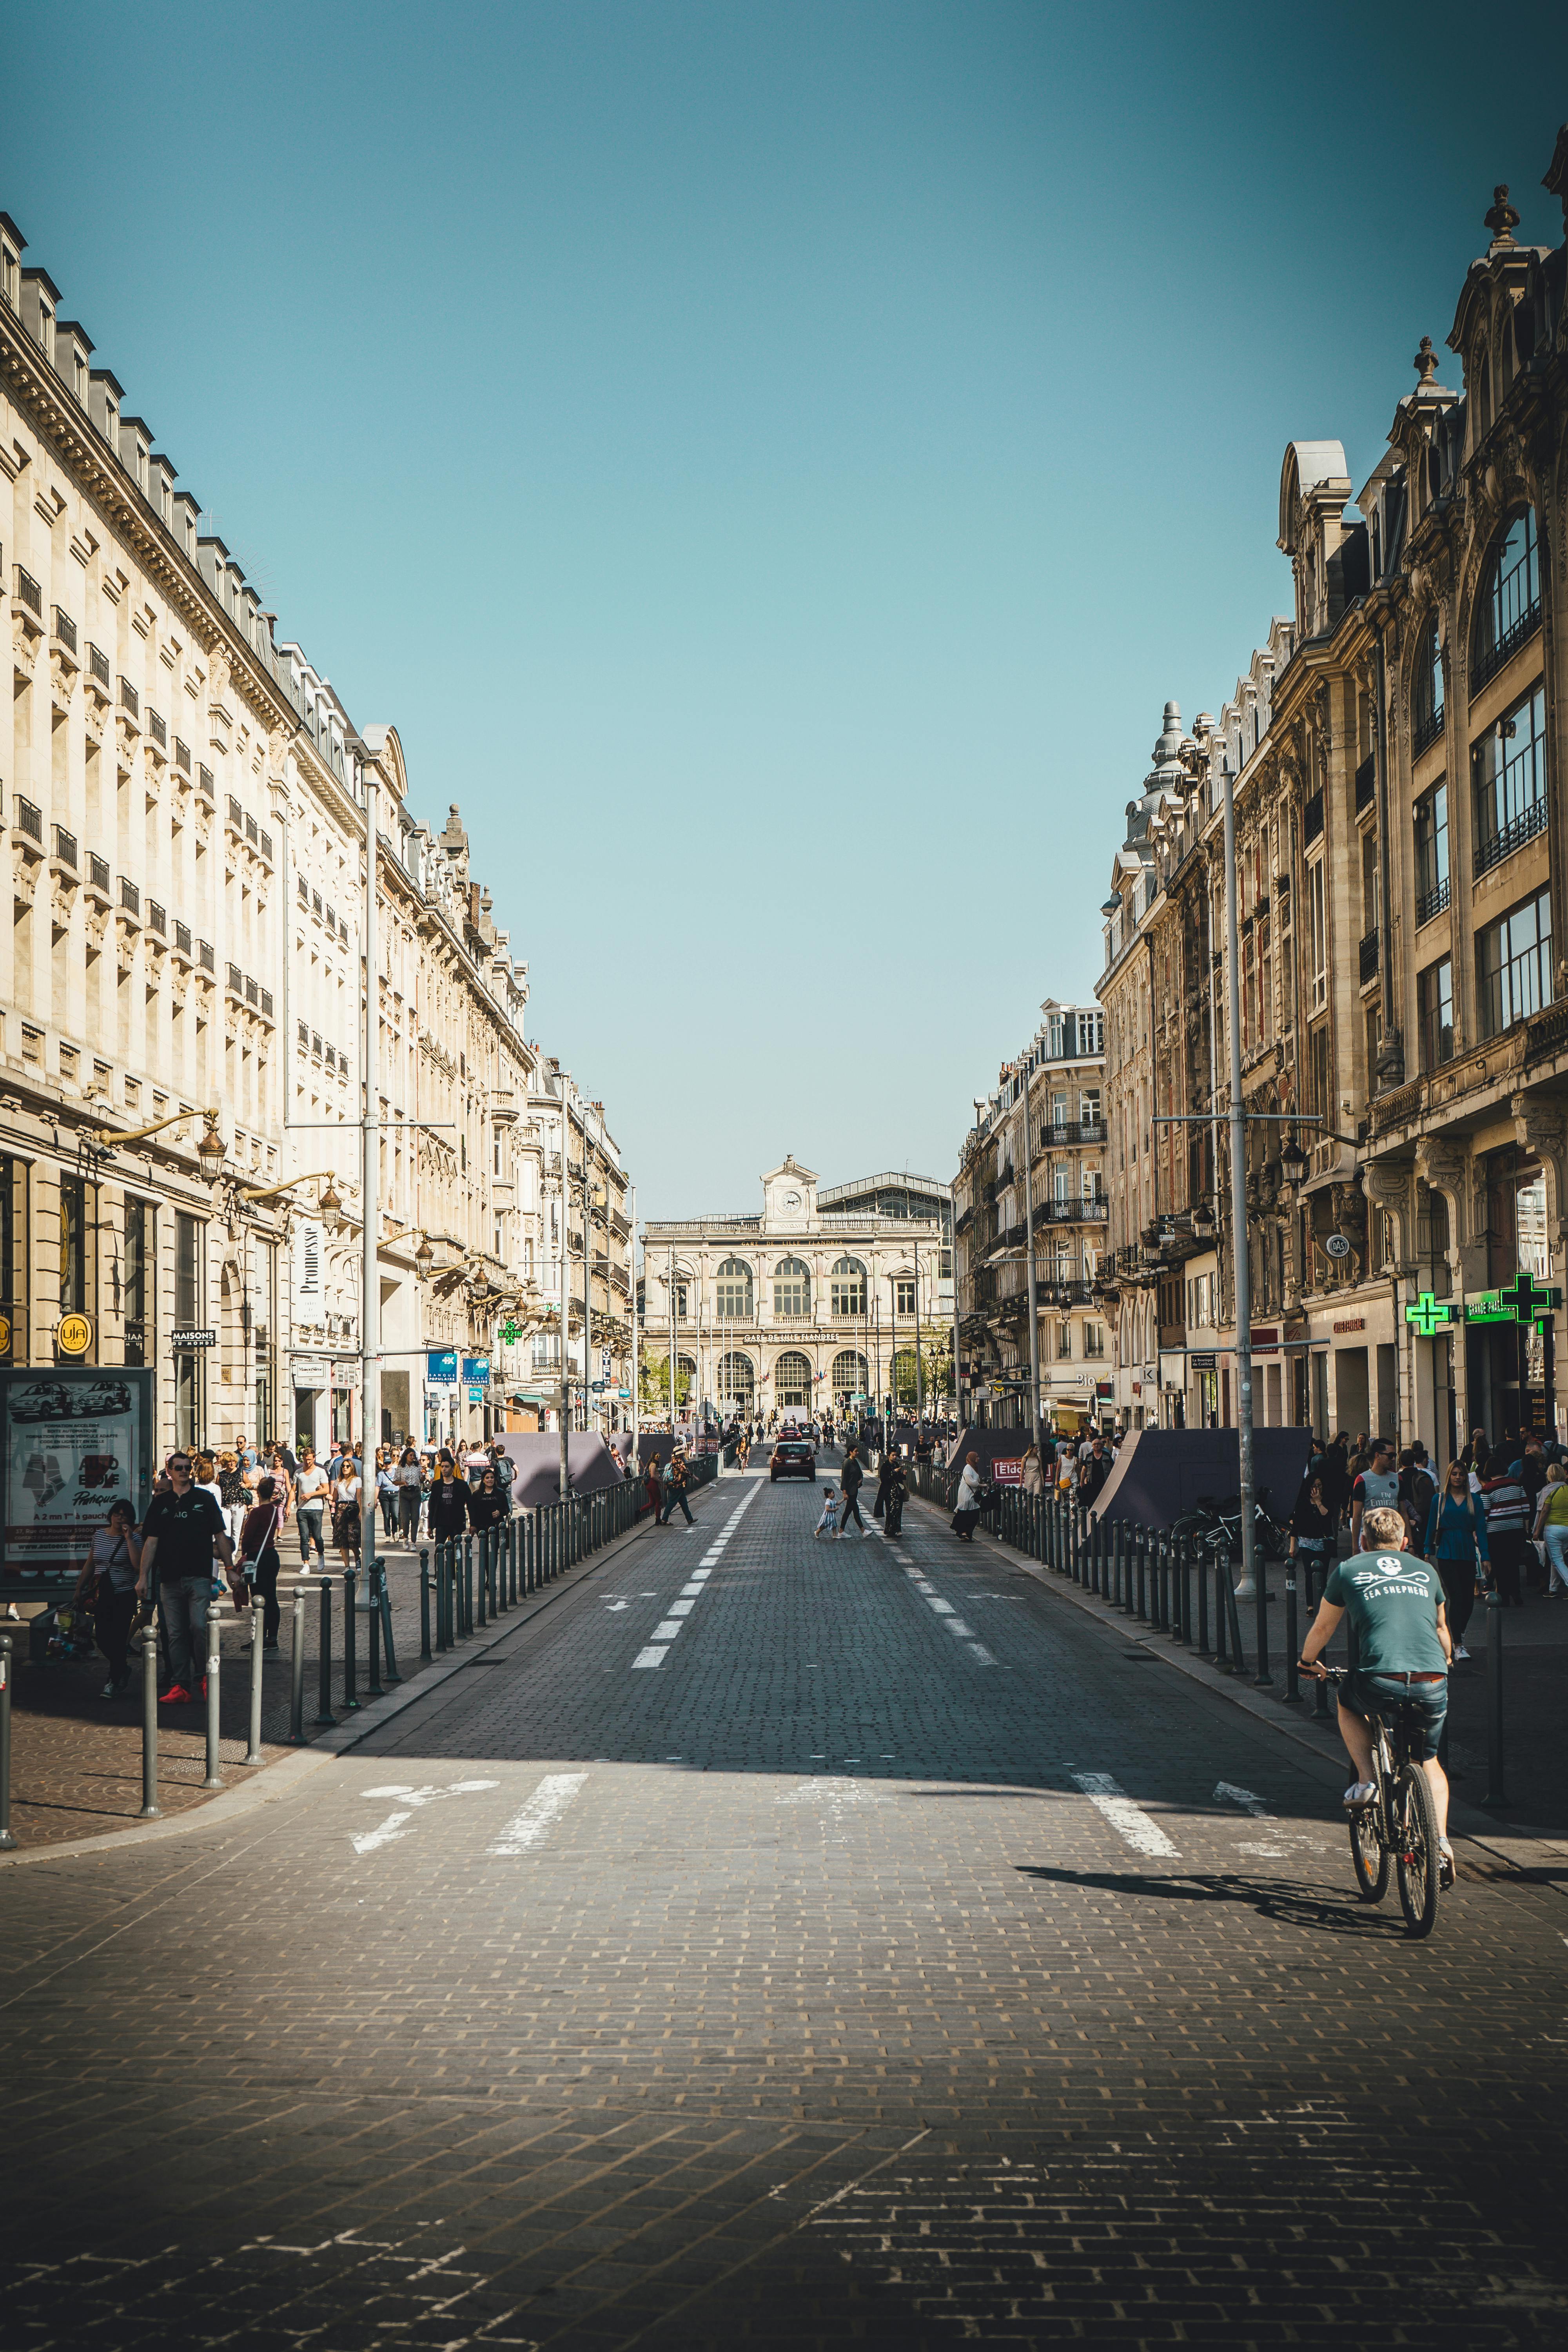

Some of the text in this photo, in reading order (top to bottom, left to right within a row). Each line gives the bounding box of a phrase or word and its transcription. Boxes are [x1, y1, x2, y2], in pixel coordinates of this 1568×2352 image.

[300, 1227, 318, 1293] Promesse
[1468, 1302, 1486, 1316] GRANDE
[1076, 1373, 1096, 1387] Bio
[1144, 1370, 1153, 1379] K
[79, 1458, 118, 1470] AUTO
[79, 1474, 119, 1485] ECOLE
[82, 1512, 107, 1521] gauch
[1363, 1586, 1428, 1601] SEA SHEPHERD
